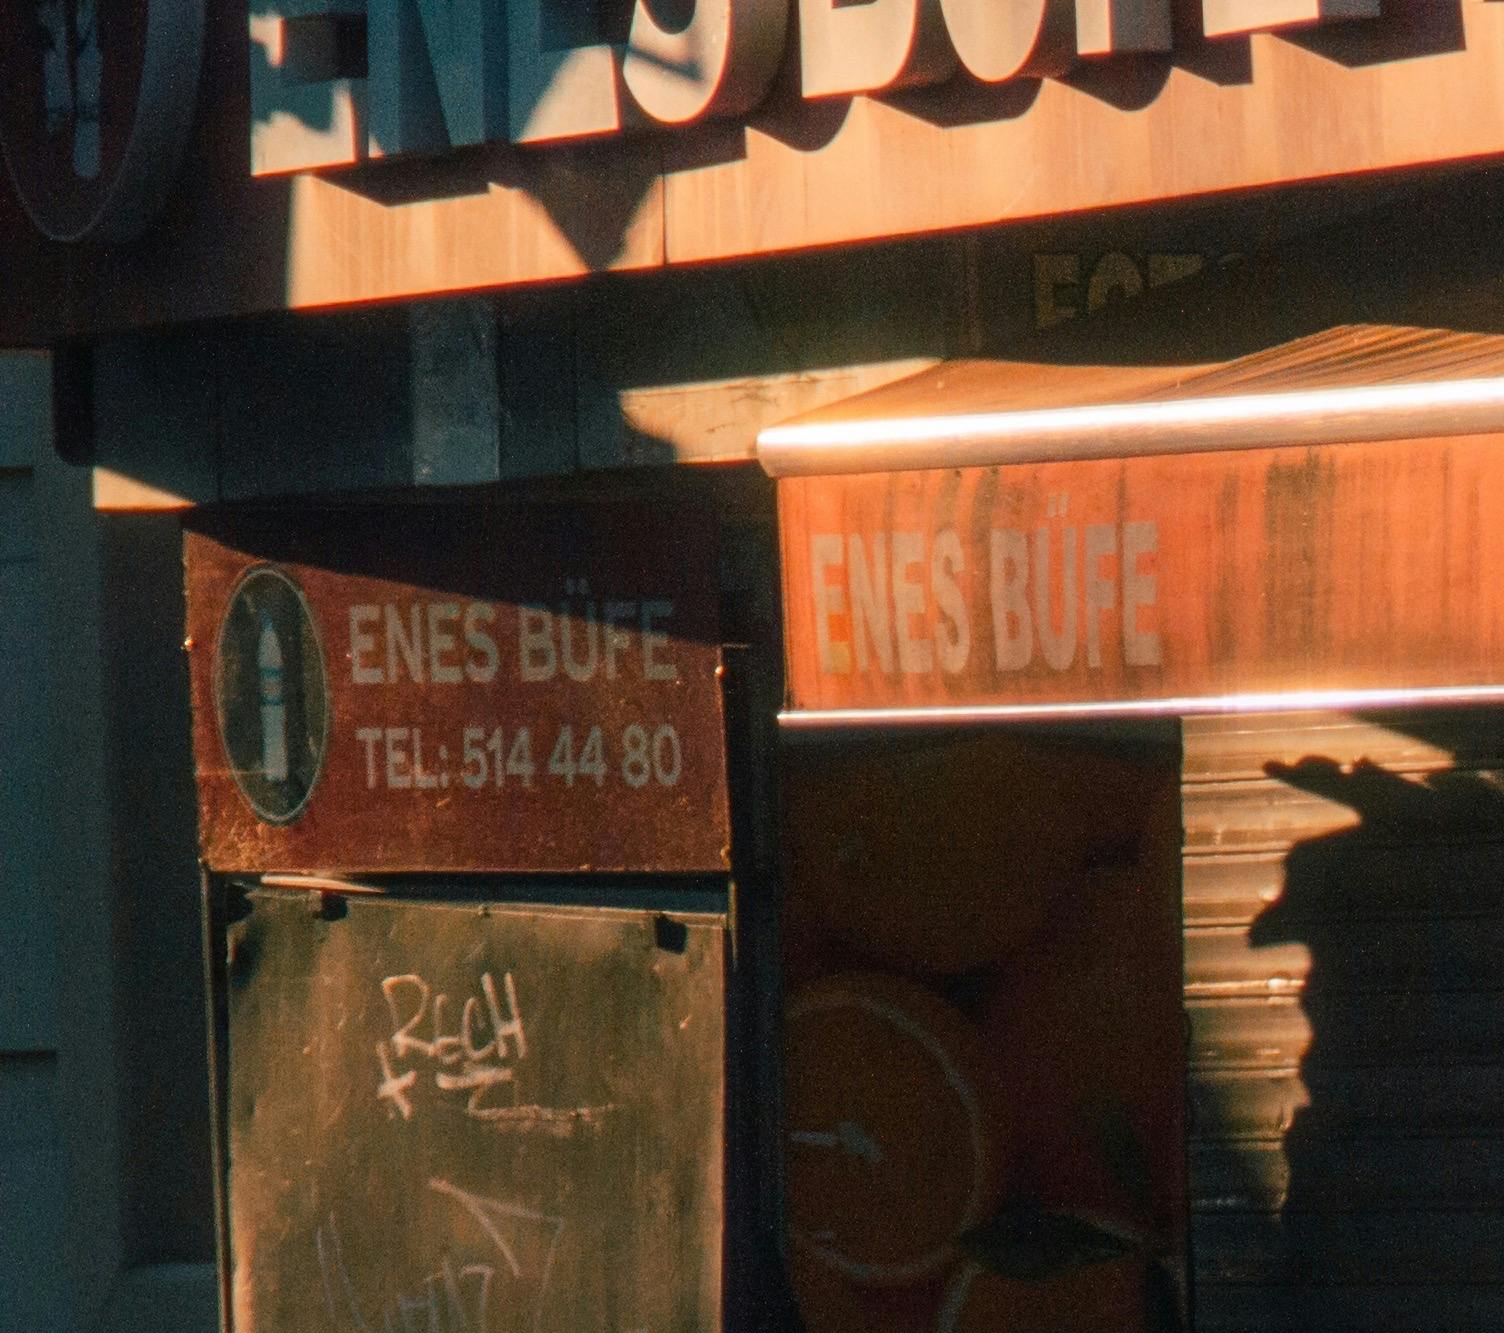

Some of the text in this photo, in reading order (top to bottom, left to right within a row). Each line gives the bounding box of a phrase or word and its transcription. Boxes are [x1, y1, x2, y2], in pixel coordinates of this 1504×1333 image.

[348, 578, 681, 686] ENES BÜFE
[810, 491, 1163, 675] ENES BÜFE
[356, 721, 682, 791] TEL: 514 44 80
